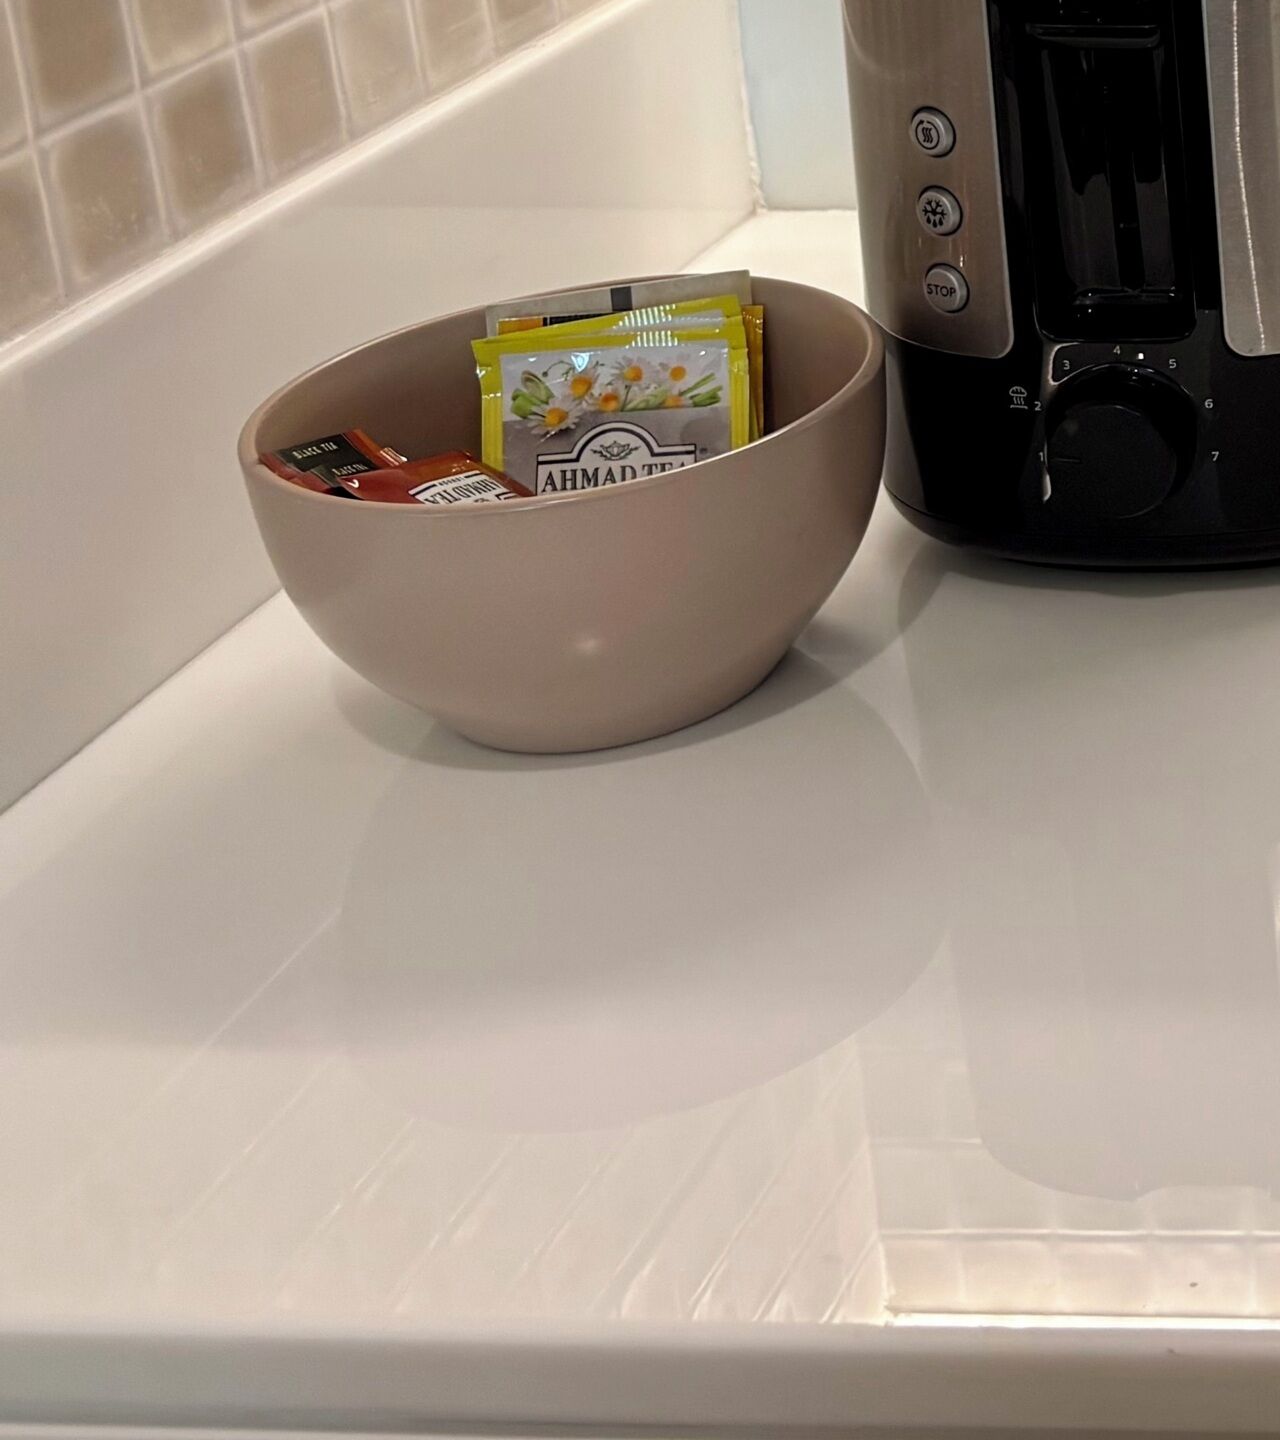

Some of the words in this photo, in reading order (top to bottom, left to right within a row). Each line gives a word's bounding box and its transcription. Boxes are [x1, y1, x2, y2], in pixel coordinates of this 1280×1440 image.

[926, 283, 957, 298] STOP
[1113, 345, 1121, 356] 4
[1063, 360, 1070, 370] 3
[1168, 359, 1177, 369] 5
[1034, 401, 1042, 411] 2
[1204, 398, 1214, 409] 6
[1211, 451, 1220, 462] 7
[541, 464, 638, 493] AHMAD
